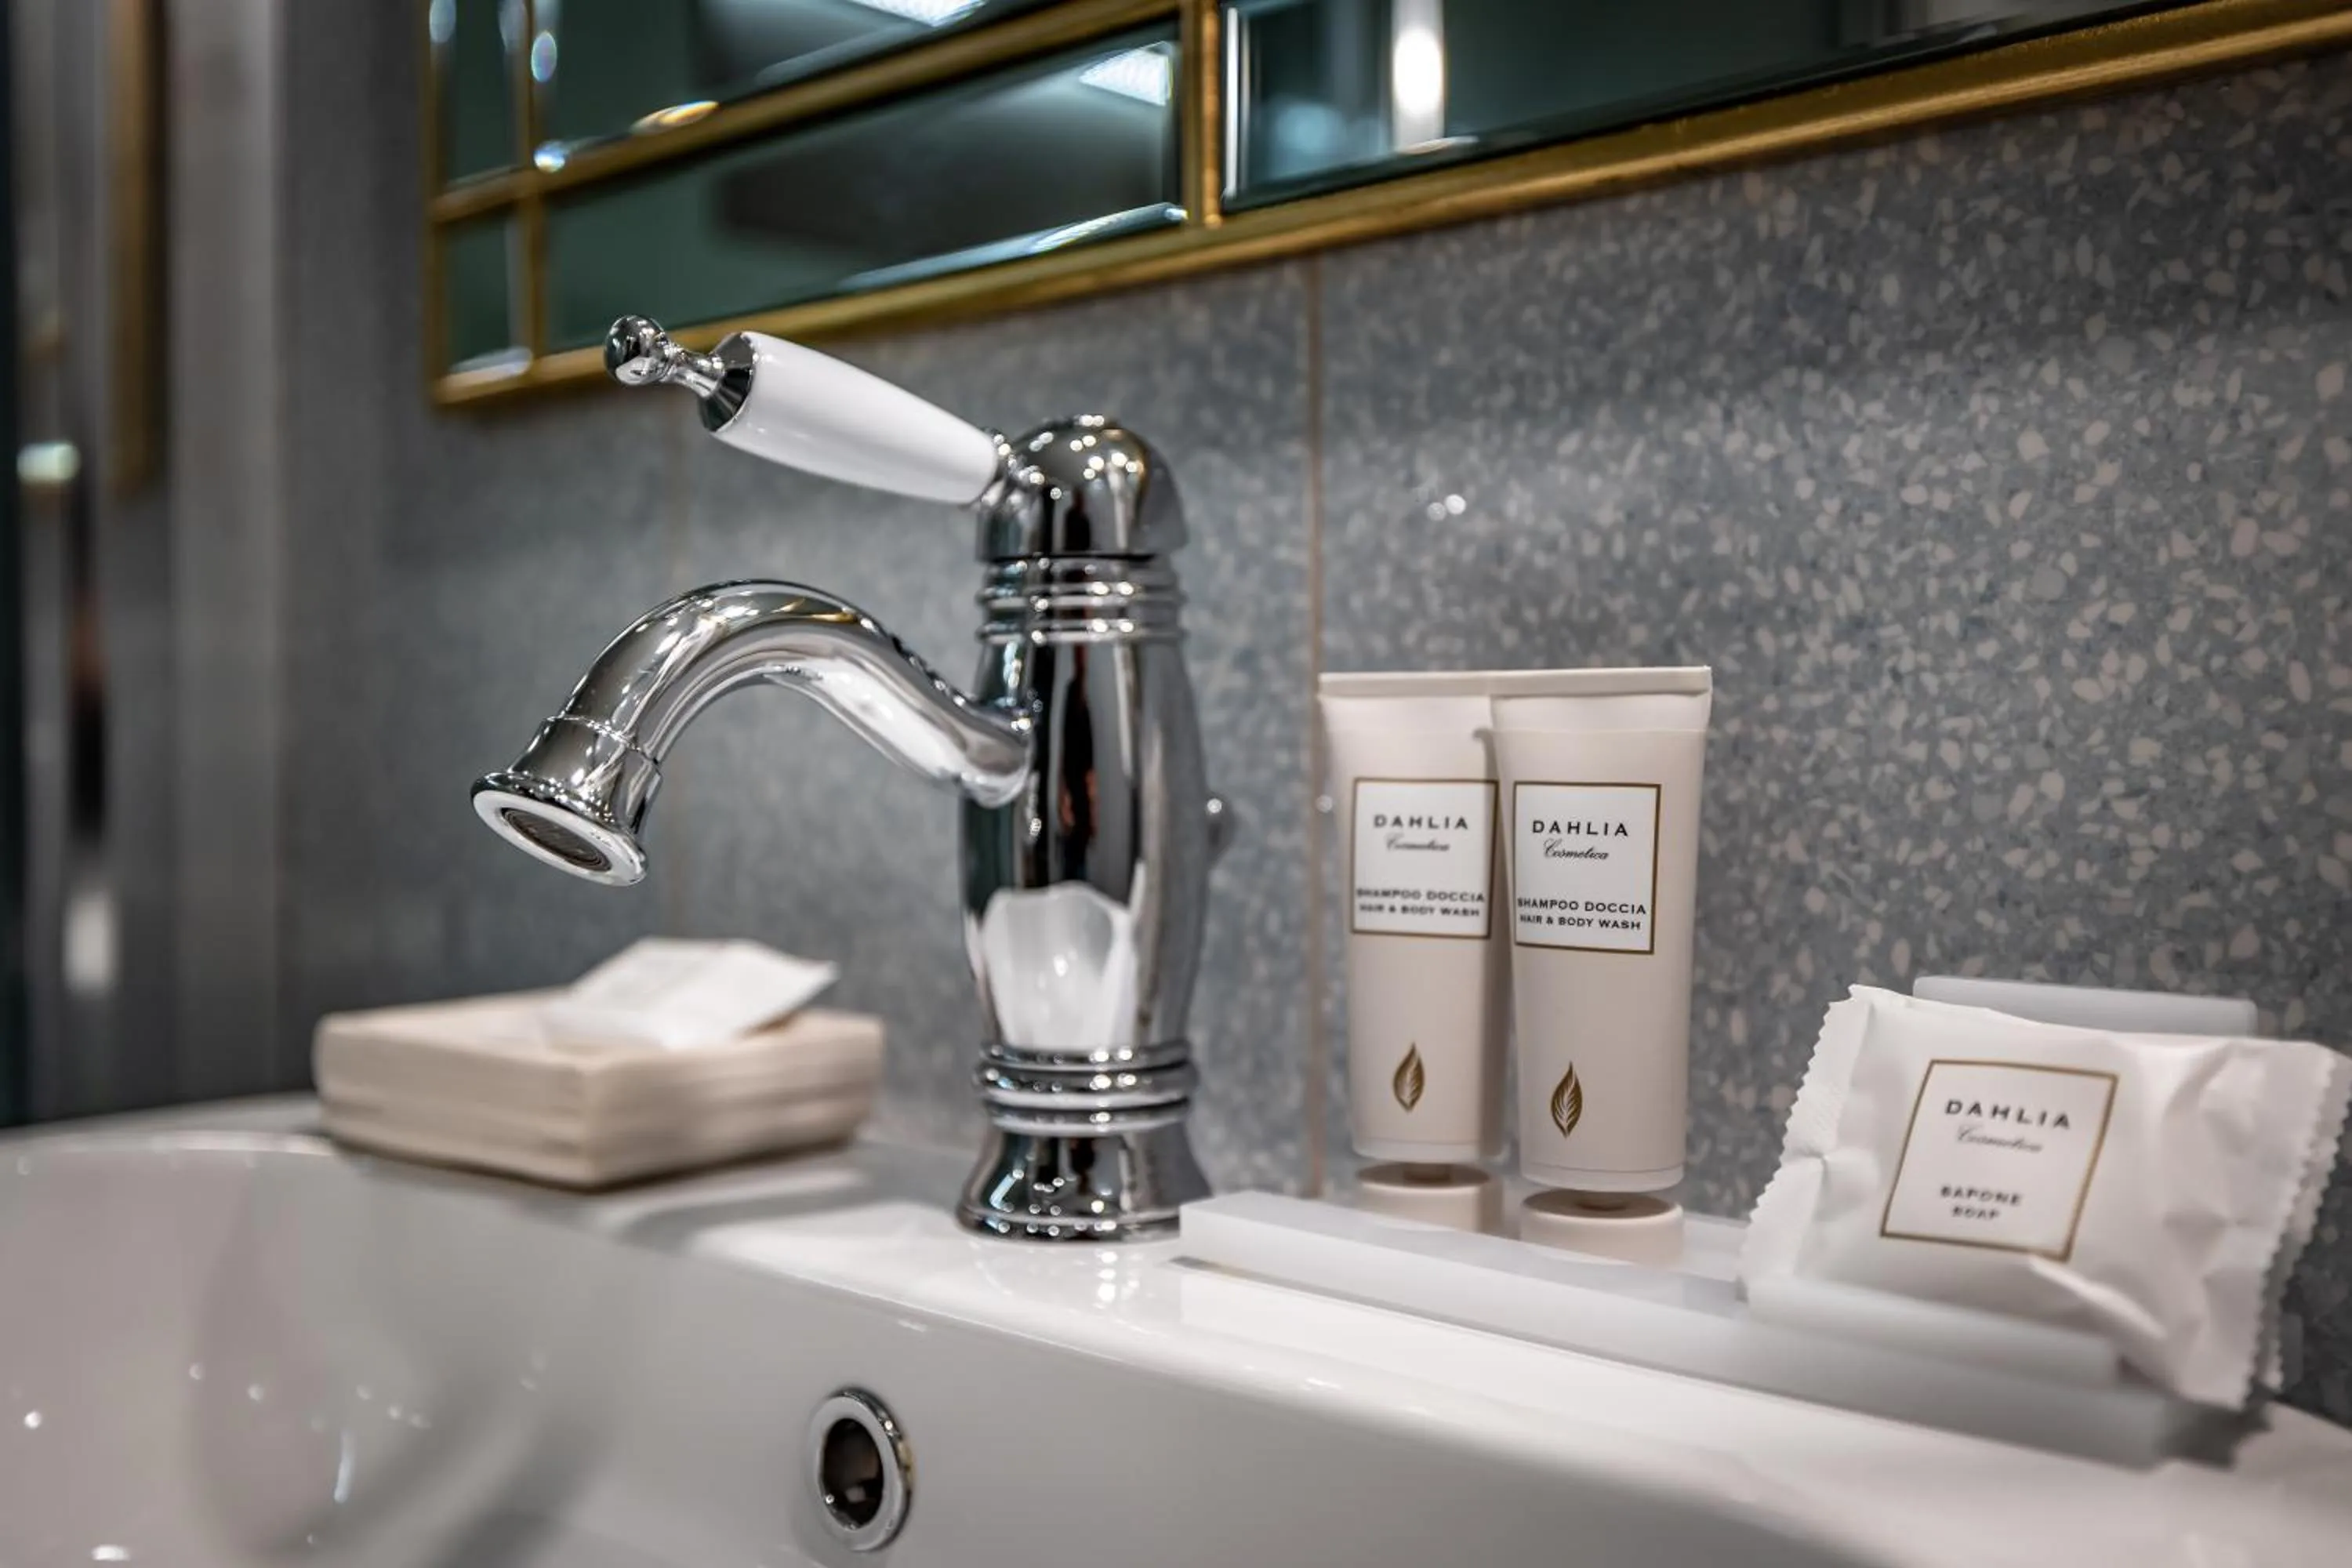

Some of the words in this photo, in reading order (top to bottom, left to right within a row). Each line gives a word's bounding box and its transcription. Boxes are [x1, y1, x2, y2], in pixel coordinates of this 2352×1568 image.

[1374, 815, 1468, 829] DAHLIA
[1533, 820, 1628, 837] DAHLIA
[1544, 838, 1609, 860] Cosmetica
[1356, 888, 1421, 900] SHAMPOO
[1426, 891, 1485, 902] DOCCIA
[1359, 903, 1384, 913] HAIR
[1389, 905, 1396, 913] &
[1401, 905, 1436, 916] BODY
[1440, 907, 1479, 917] WASH
[1517, 898, 1579, 911] SHAMPOO
[1584, 902, 1646, 915] DOCCIA
[1519, 915, 1542, 924] HAIR
[1546, 916, 1553, 925] &
[1559, 916, 1594, 928] BODY
[1599, 920, 1641, 931] WASH
[1945, 1099, 2071, 1129] DAHLIA
[1940, 1186, 2022, 1206] SAPONE
